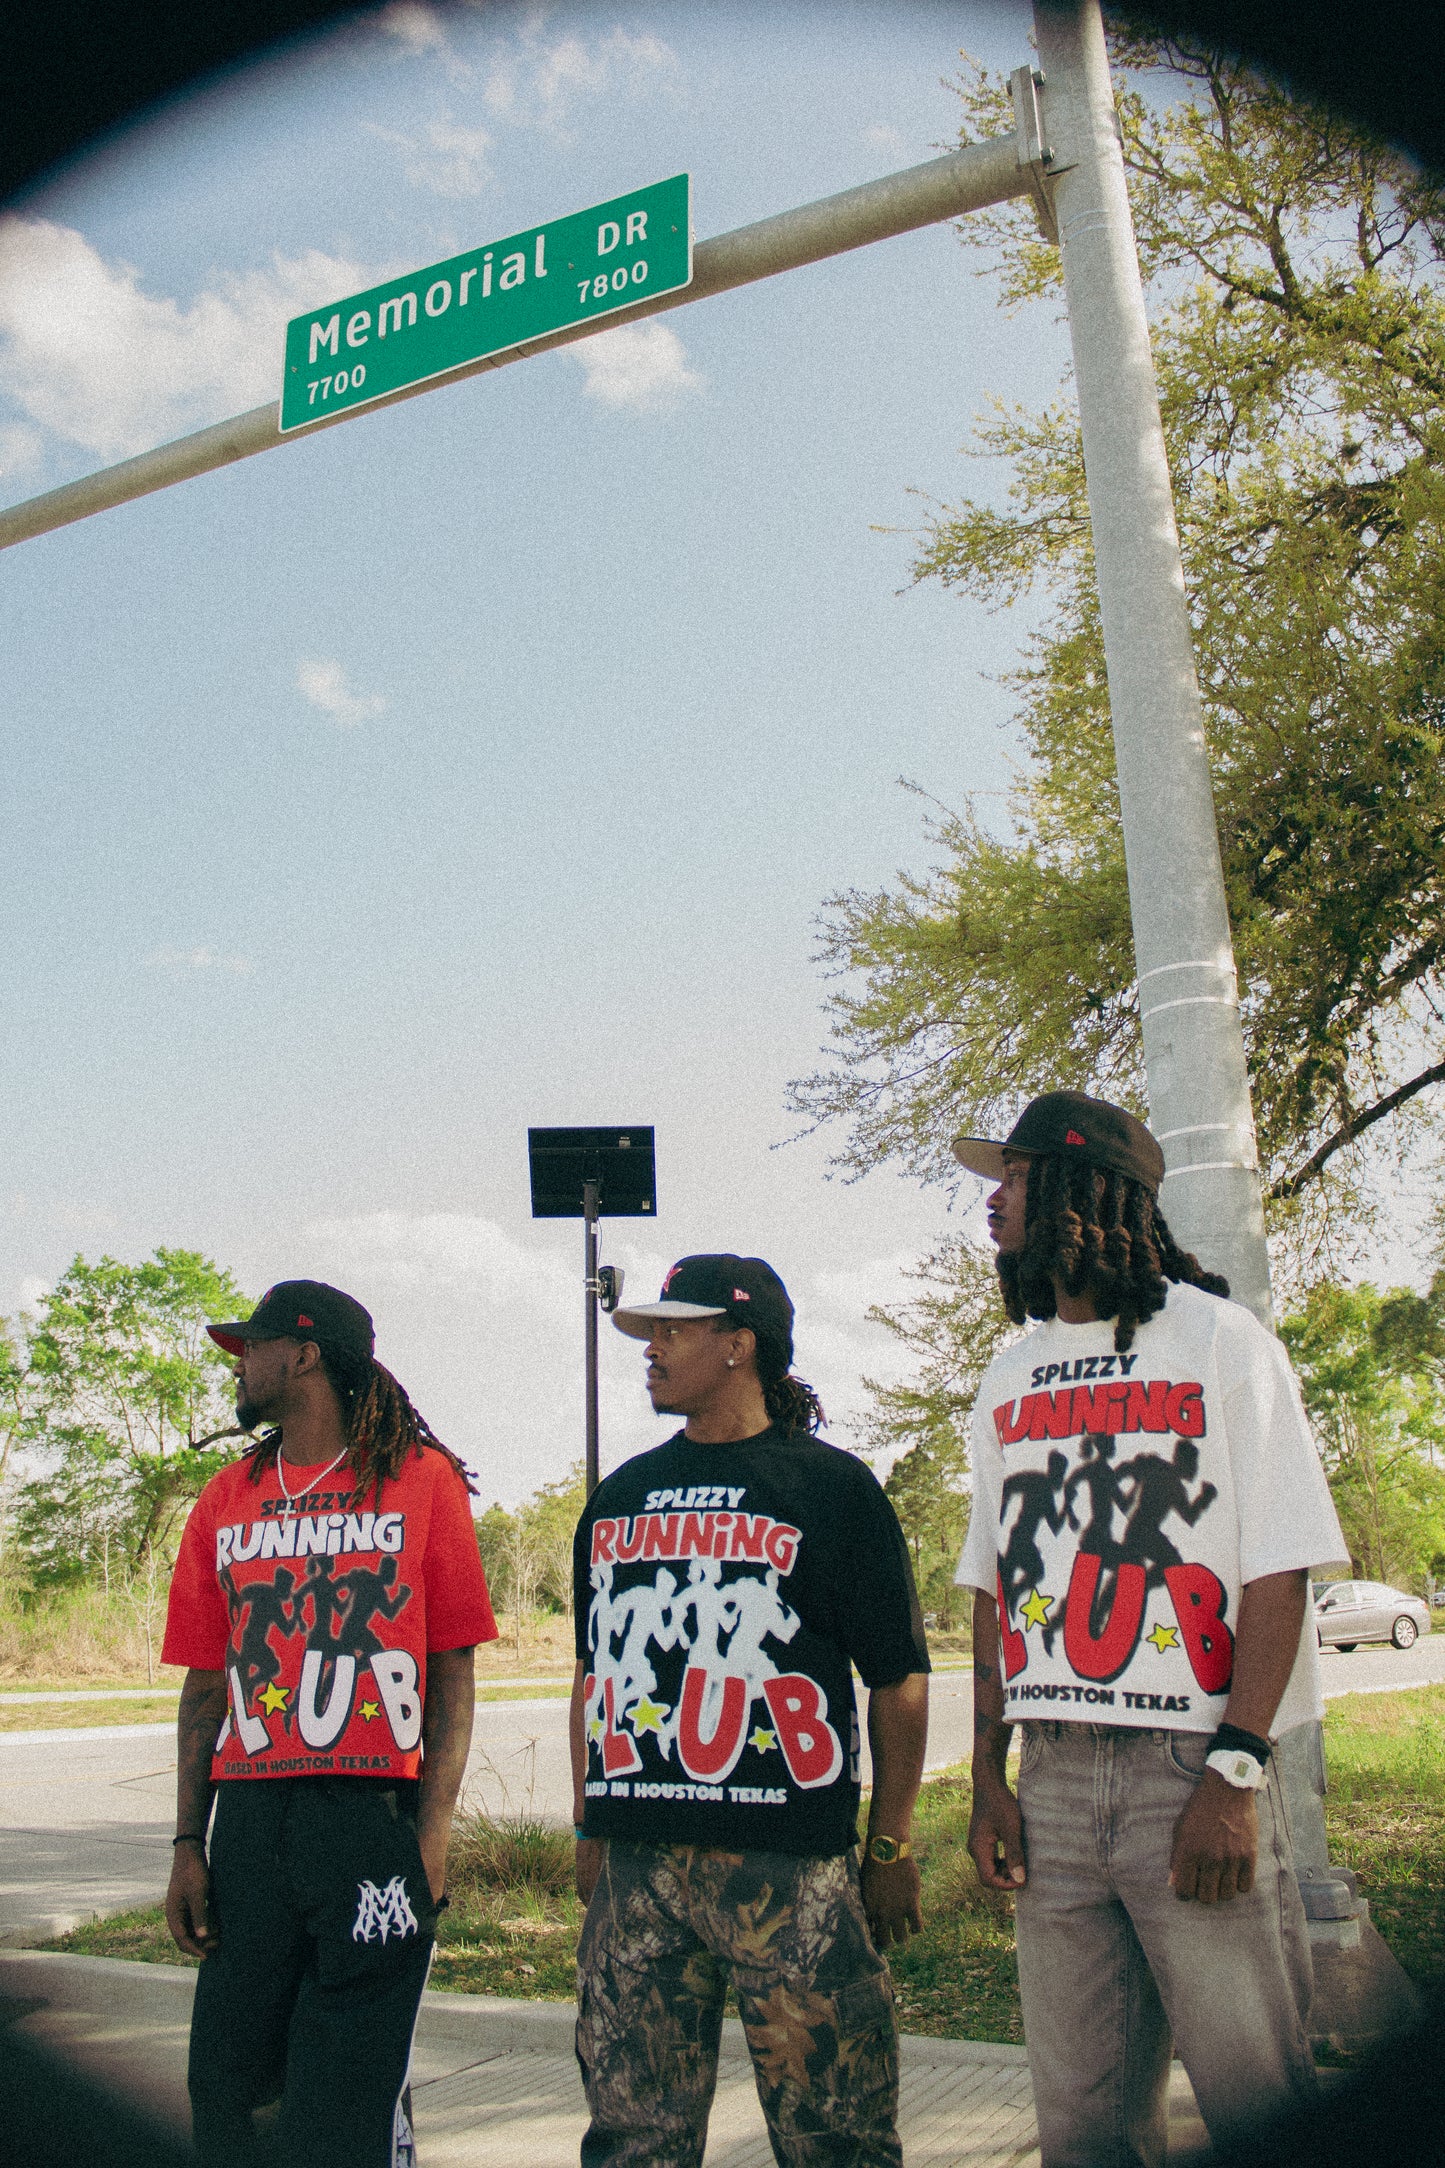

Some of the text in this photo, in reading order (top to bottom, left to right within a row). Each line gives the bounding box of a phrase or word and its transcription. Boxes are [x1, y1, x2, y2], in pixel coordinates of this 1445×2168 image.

[308, 210, 649, 364] Memorial DR
[577, 260, 648, 304] 7800
[307, 364, 366, 405] 7700
[1031, 1353, 1138, 1388] SPLIZZY
[261, 1492, 352, 1516] SPLIZZY
[645, 1486, 746, 1511] SPLIZZY
[996, 1550, 1236, 1696] LUB
[1020, 1684, 1115, 1706] HOUSTON
[1122, 1691, 1190, 1712] TEXAS
[584, 1663, 844, 1790] LUB
[256, 1760, 267, 1773] IN
[270, 1756, 333, 1773] HOUSTON
[339, 1755, 391, 1770] TEXAS
[611, 1781, 629, 1797] IN
[634, 1782, 723, 1801] HOUSTON
[728, 1786, 787, 1804] TEXAS
